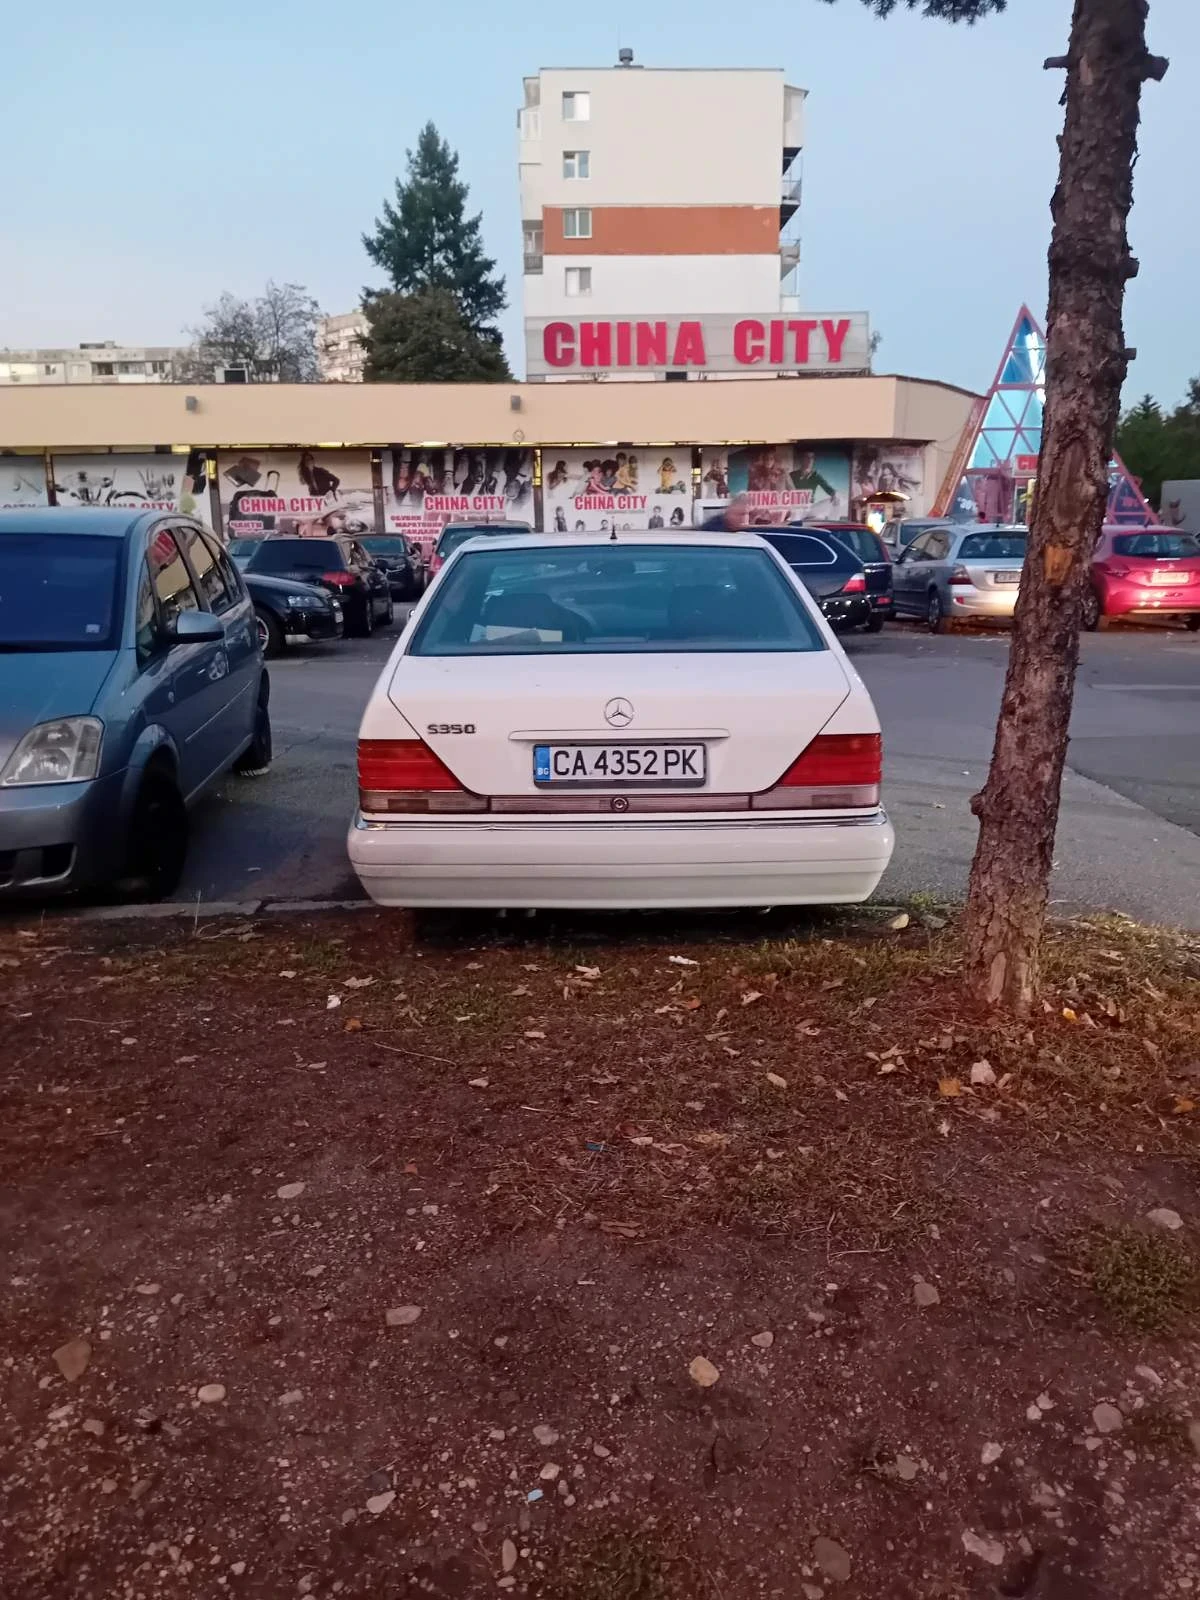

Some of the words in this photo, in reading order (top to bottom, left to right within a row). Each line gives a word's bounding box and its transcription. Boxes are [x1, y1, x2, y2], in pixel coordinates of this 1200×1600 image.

[543, 321, 707, 367] CHINA
[733, 319, 851, 365] CITY
[425, 496, 469, 510] CHINA
[473, 496, 505, 510] CITY
[575, 496, 615, 510] CHINA
[618, 495, 647, 510] CITY
[782, 491, 810, 505] CITY
[240, 498, 287, 513] CHINA
[290, 498, 324, 512] CITY
[427, 723, 476, 735] S350
[553, 750, 588, 776] CA
[593, 750, 659, 776] 4352
[663, 748, 698, 775] PK
[537, 767, 549, 776] BG
